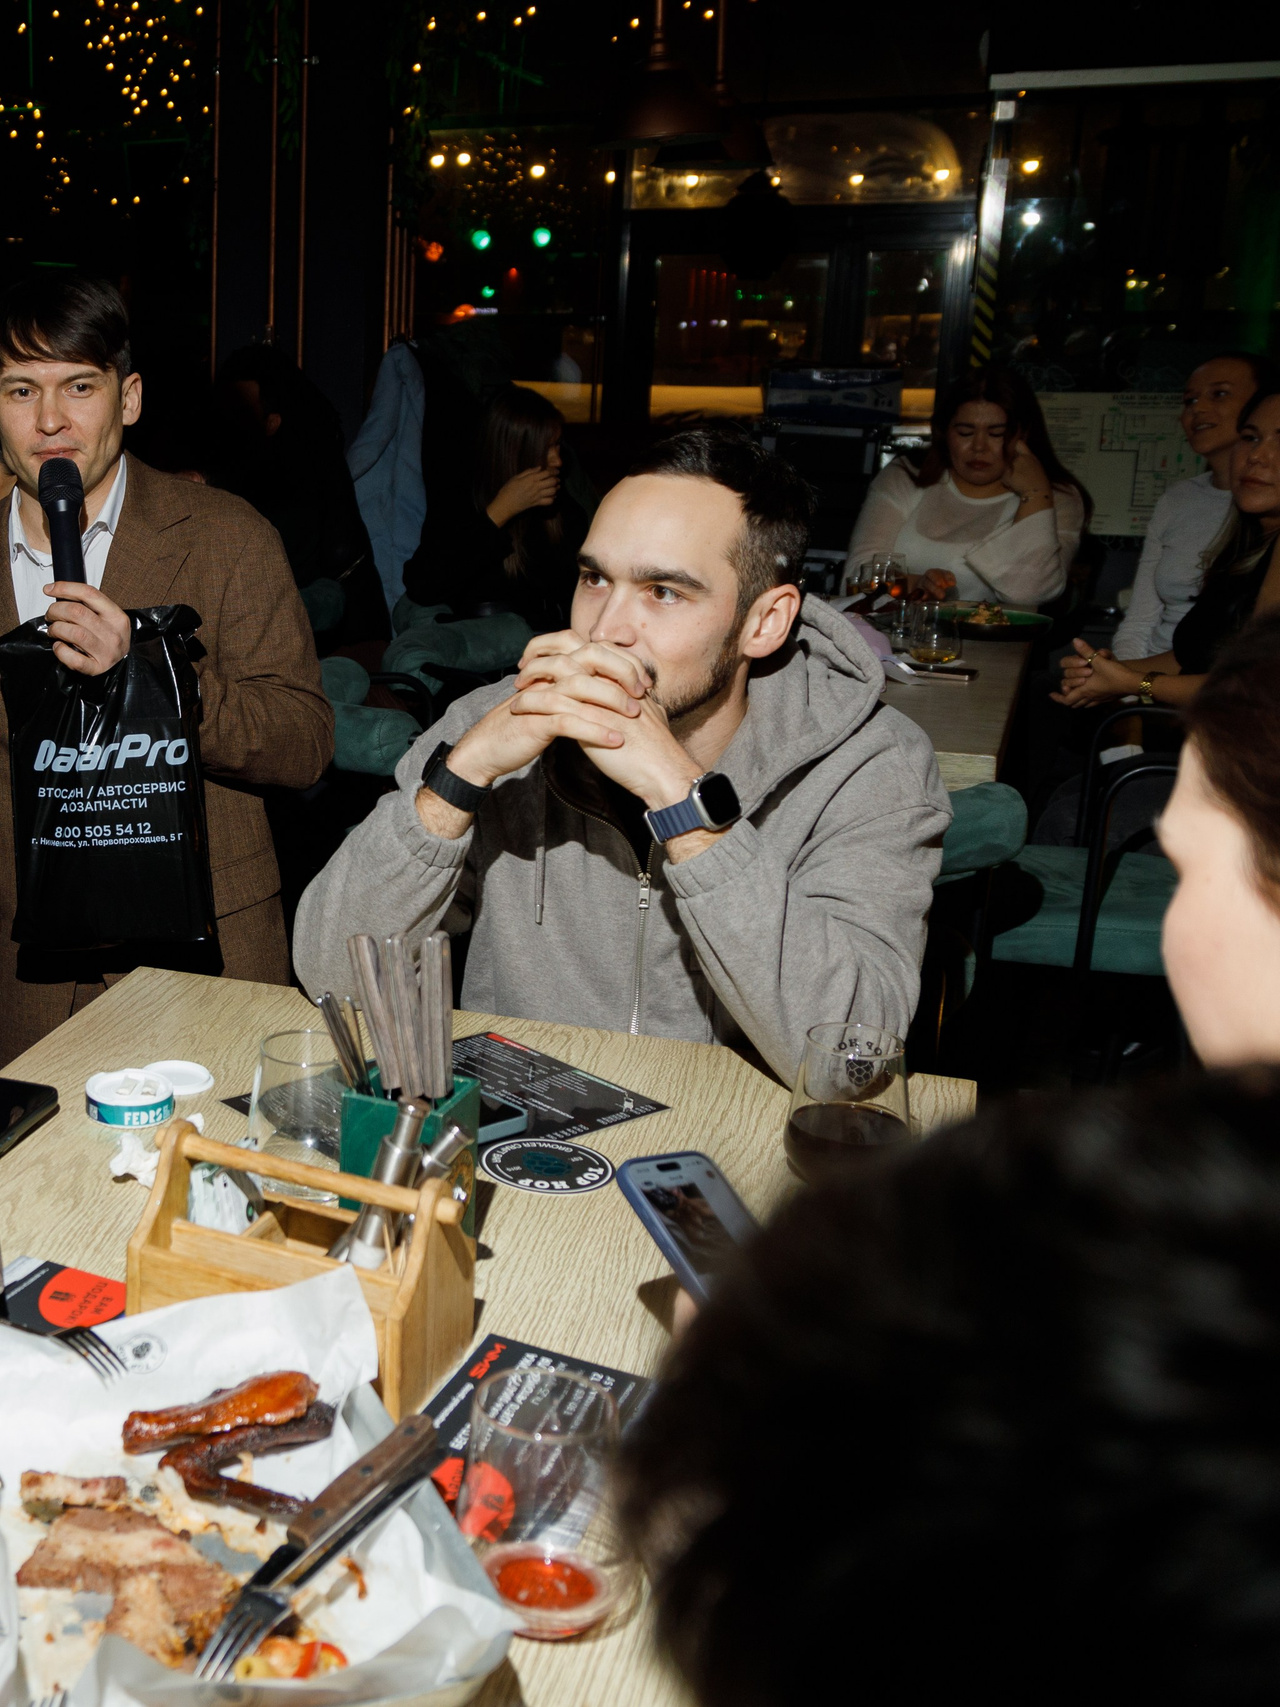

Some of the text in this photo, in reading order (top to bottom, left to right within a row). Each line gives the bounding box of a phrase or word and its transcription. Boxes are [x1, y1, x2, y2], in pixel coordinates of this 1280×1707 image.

[97, 780, 186, 798] АВТОСЕРВИС
[85, 824, 111, 838] 505
[116, 823, 134, 836] 54
[136, 822, 151, 834] 12
[77, 840, 90, 848] ул.
[91, 834, 168, 847] Первопроходцев,
[124, 1107, 162, 1126] FEDRS
[522, 1141, 573, 1153] GROWLER
[517, 1166, 604, 1190] TOP HOP
